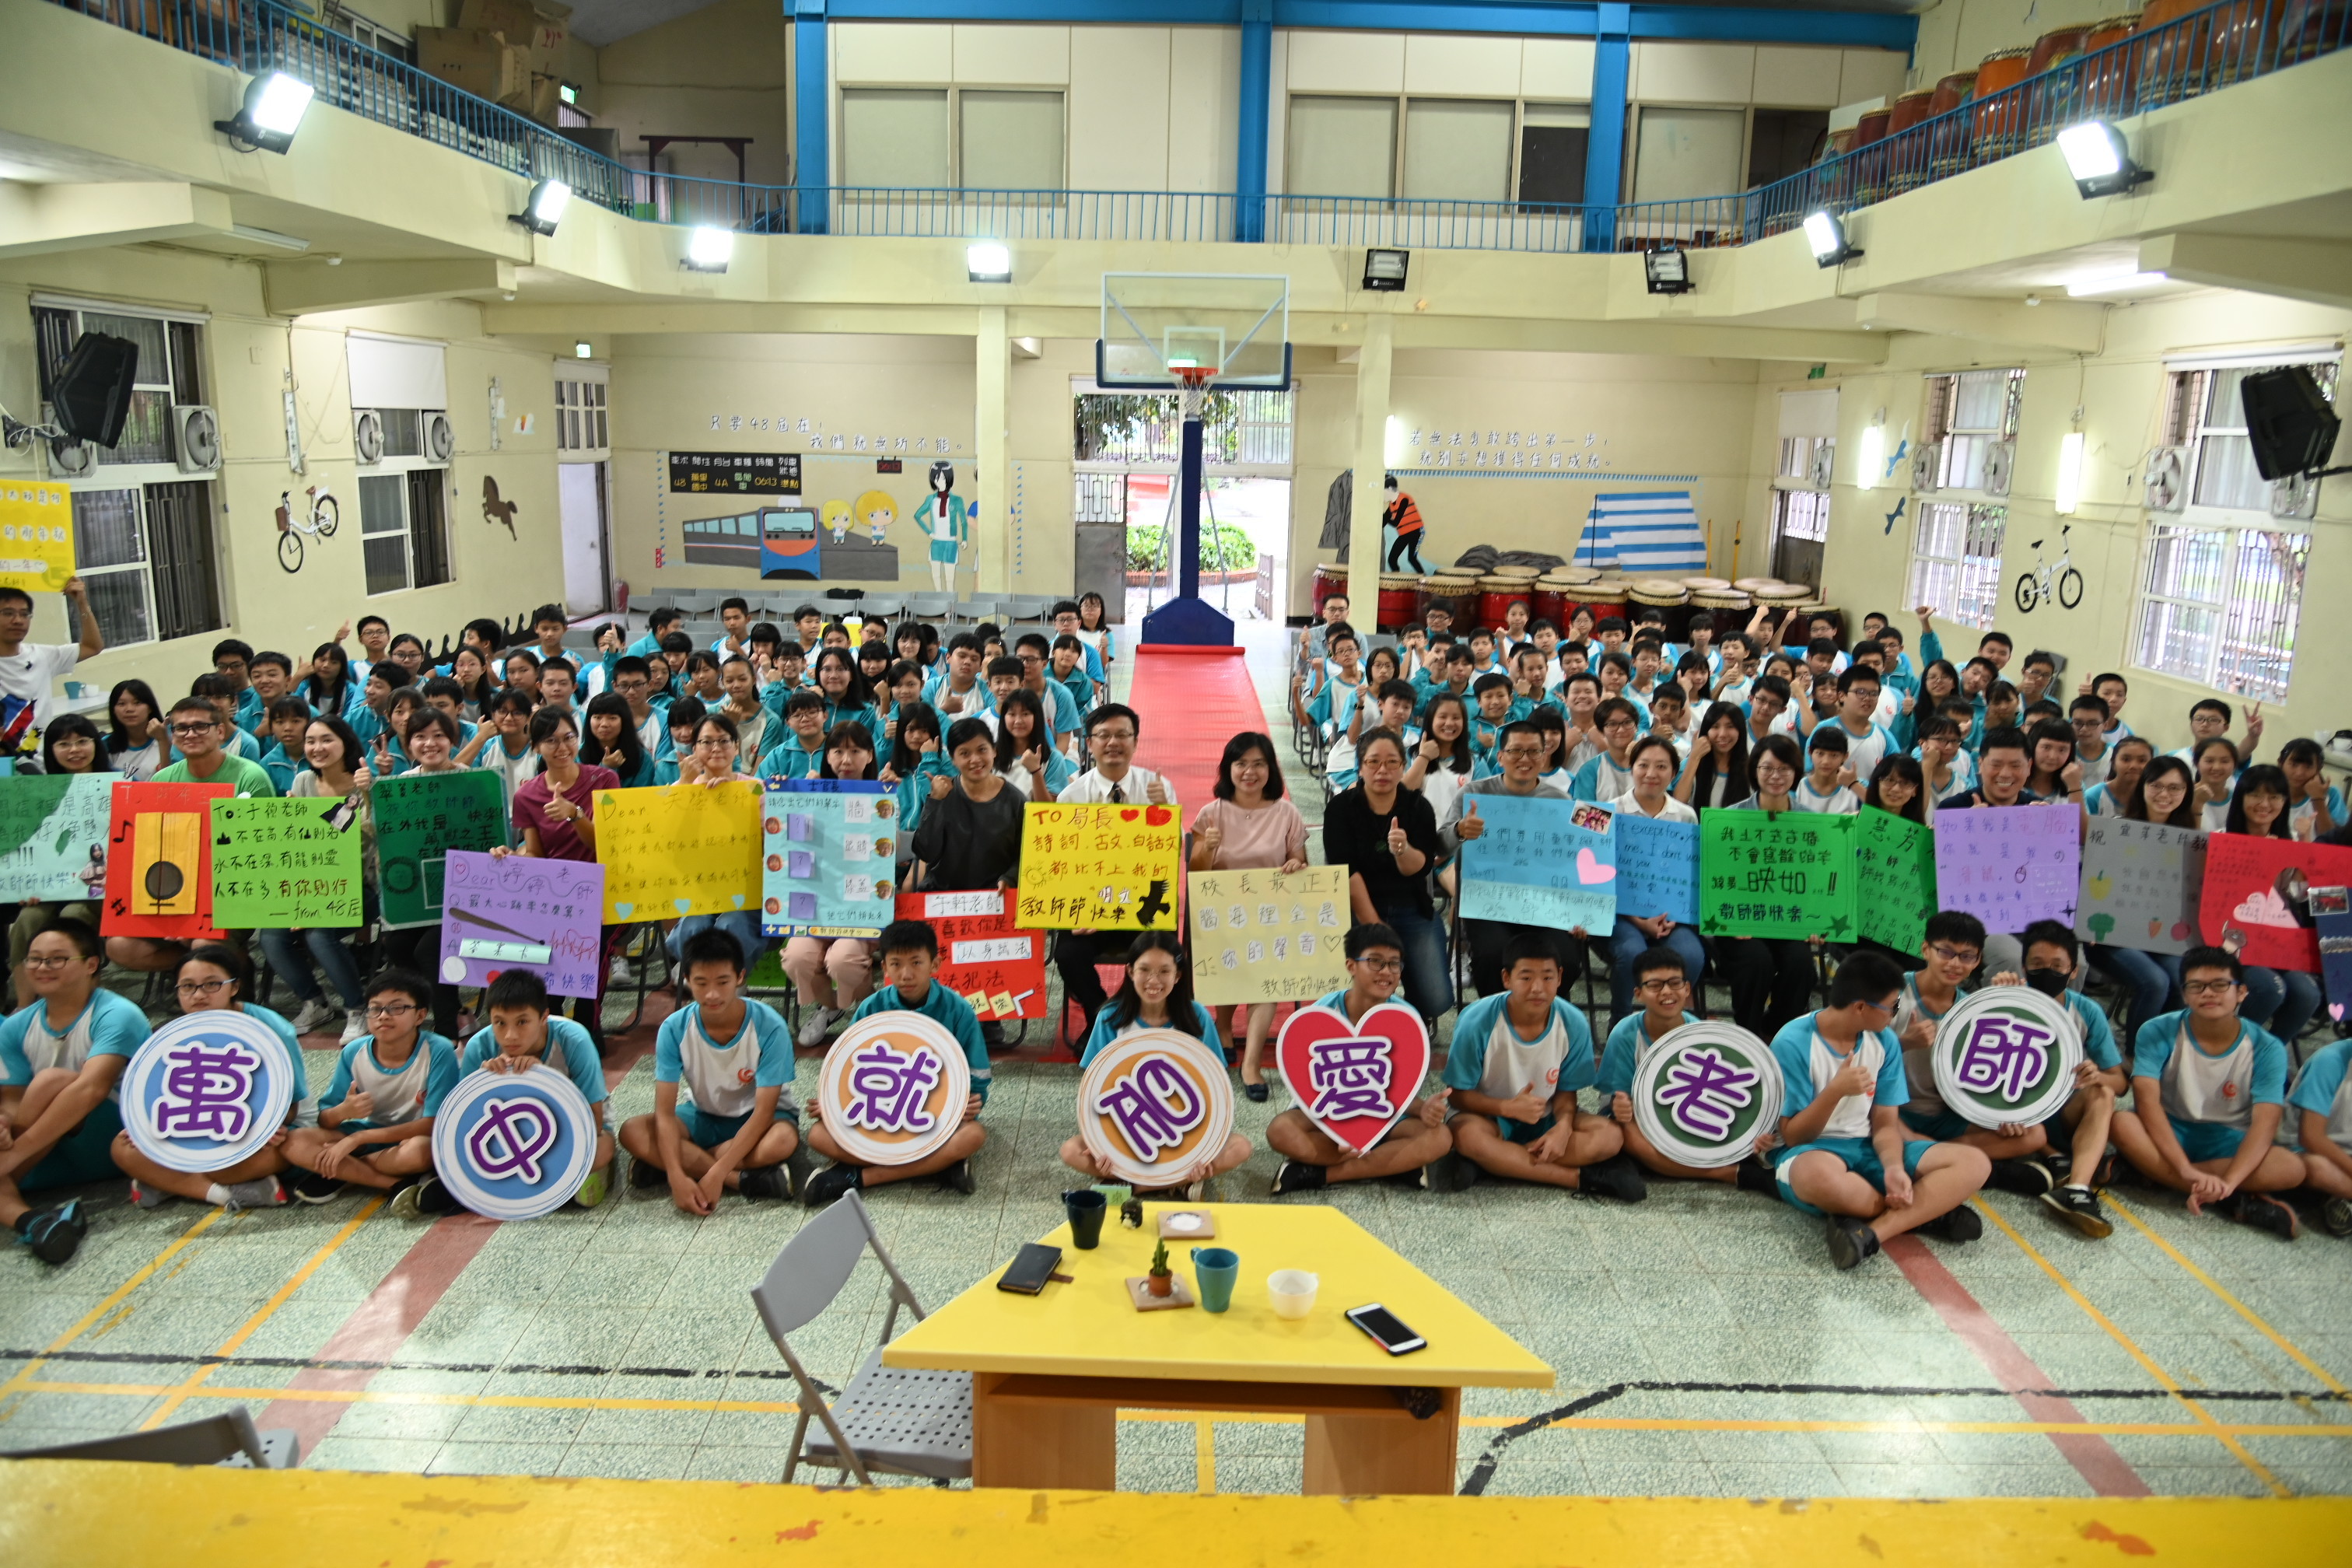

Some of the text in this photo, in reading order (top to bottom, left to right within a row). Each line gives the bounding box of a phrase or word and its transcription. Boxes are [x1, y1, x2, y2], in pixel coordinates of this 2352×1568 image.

[1032, 810, 1062, 825] TO
[158, 1046, 255, 1136] 萬
[847, 1045, 937, 1128] 就
[1311, 1041, 1391, 1115] 愛
[1661, 1052, 1756, 1136] 老
[1958, 1018, 2051, 1097] 師
